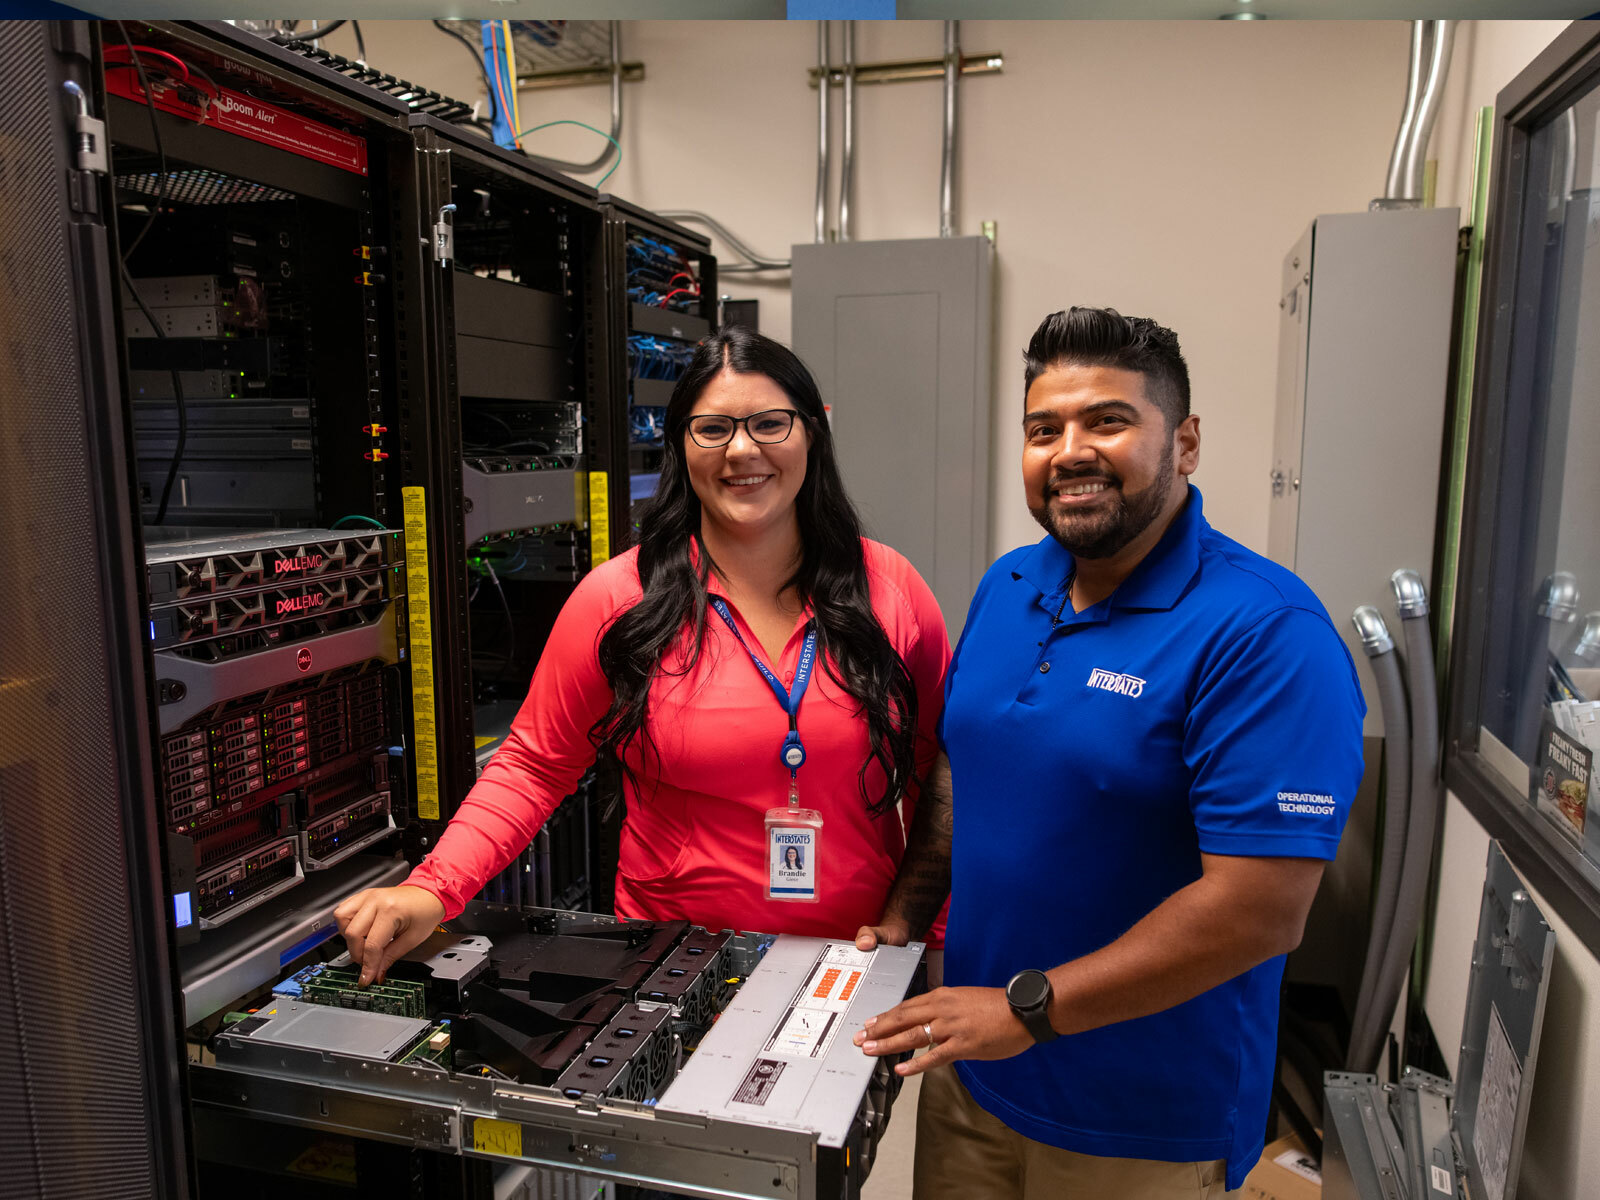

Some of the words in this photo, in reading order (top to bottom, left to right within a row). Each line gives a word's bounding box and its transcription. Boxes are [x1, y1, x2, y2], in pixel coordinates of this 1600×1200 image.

[797, 629, 817, 683] INTERSTATES
[1086, 667, 1147, 699] INTERSTATES
[1548, 742, 1571, 772] FREAKY
[1571, 760, 1588, 785] FAST
[1552, 731, 1570, 754] FREAKY
[1570, 744, 1586, 768] FRESH
[1277, 791, 1336, 805] OPERATIONAL
[1277, 802, 1335, 816] TECHNOLOGY
[778, 870, 807, 878] Brandie
